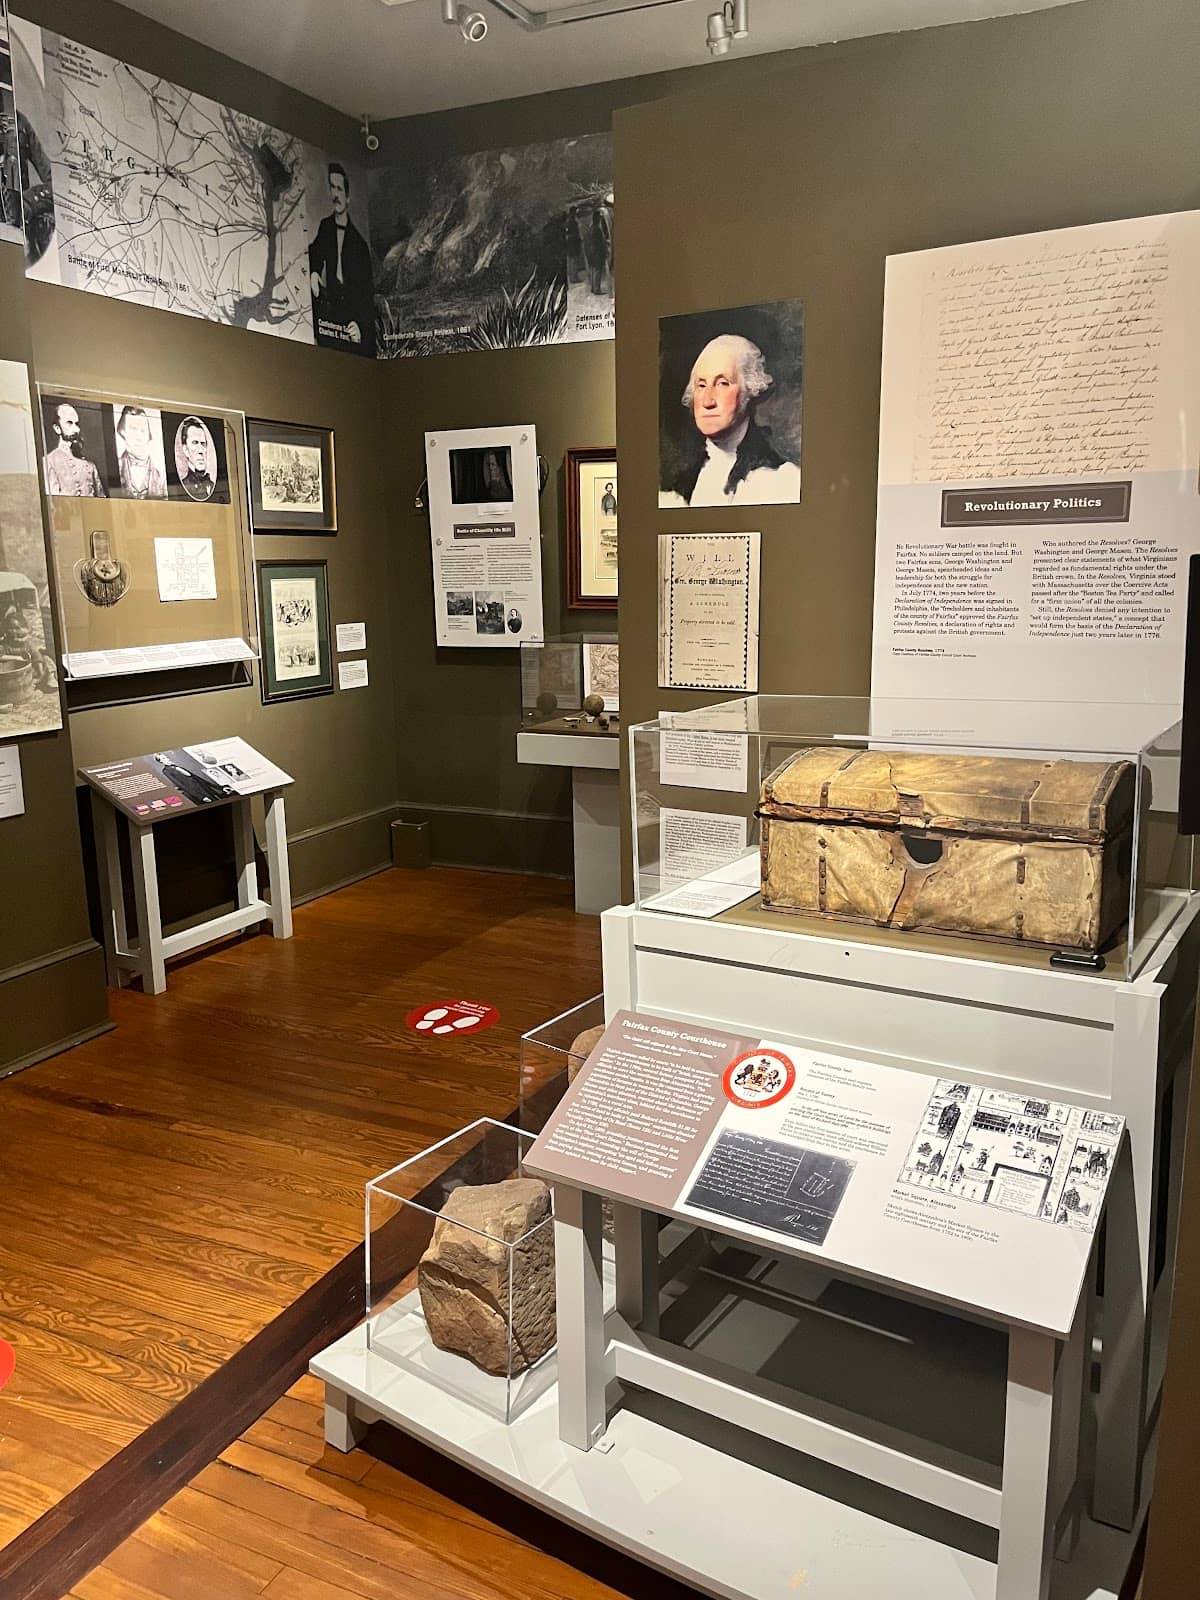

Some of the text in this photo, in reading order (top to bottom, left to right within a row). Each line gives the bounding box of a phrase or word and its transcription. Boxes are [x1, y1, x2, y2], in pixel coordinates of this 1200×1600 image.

[964, 497, 1102, 512] Revolutionary Politics
[622, 1020, 728, 1049] Fairfax County Courthouse
